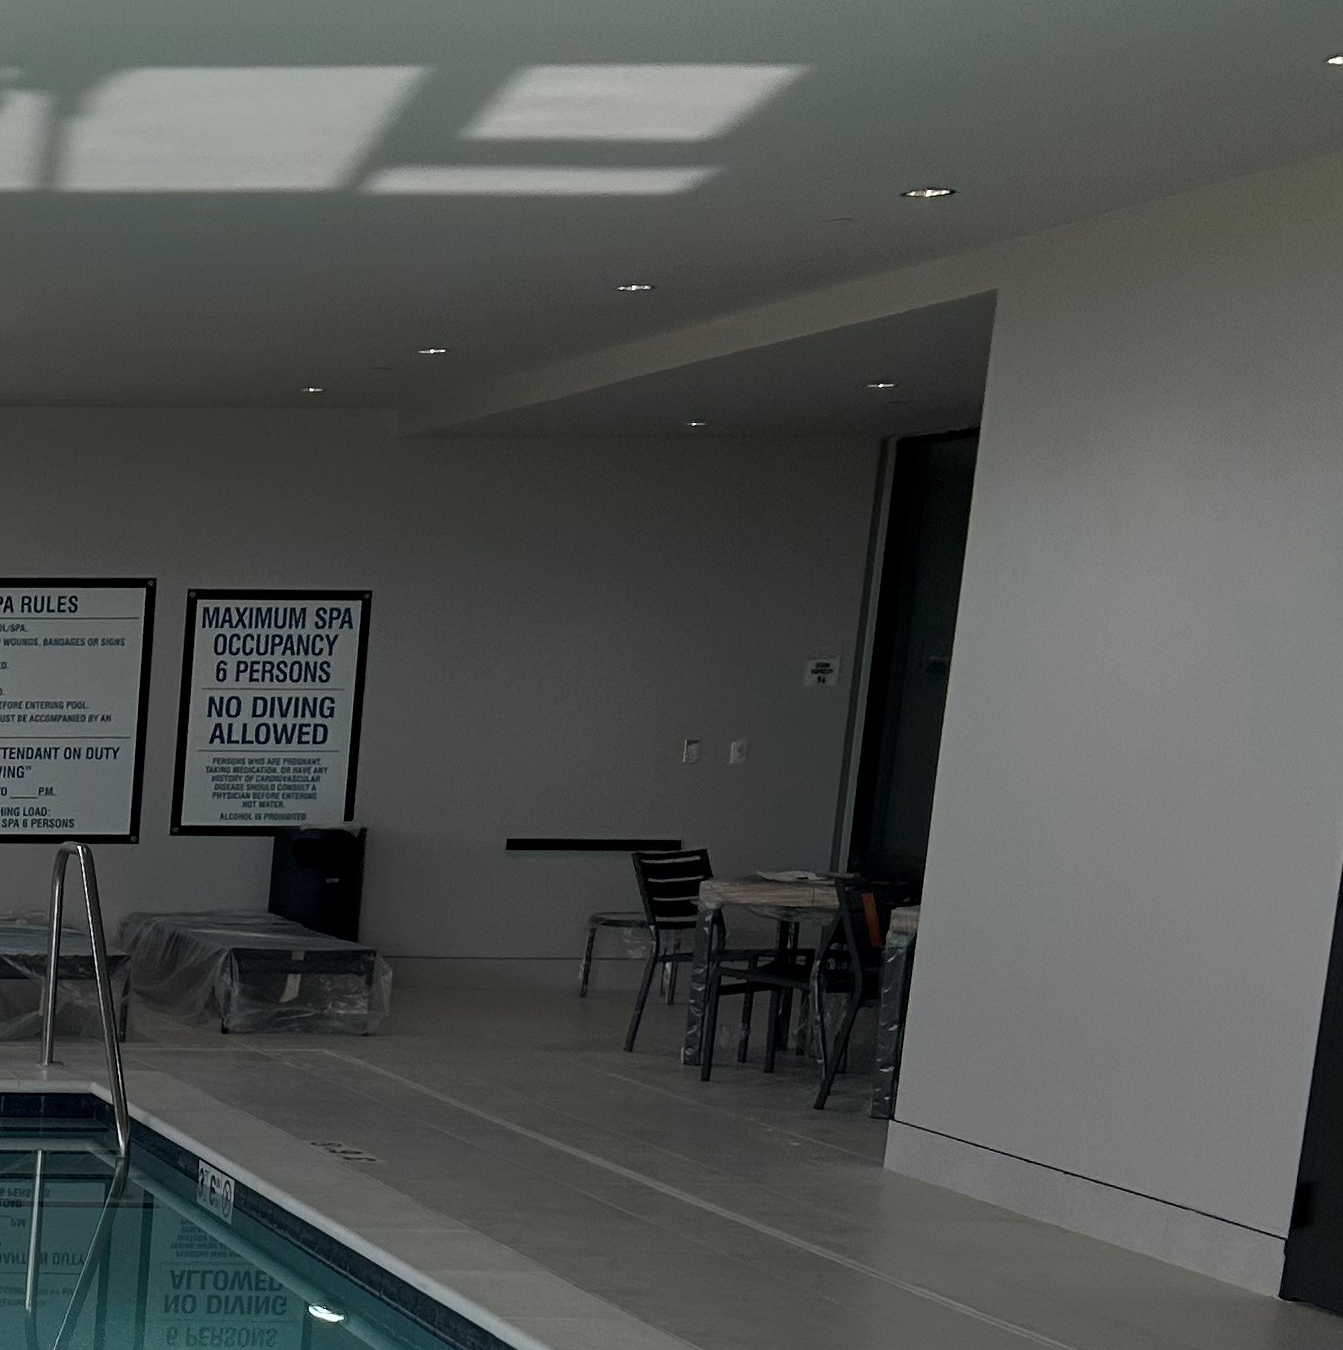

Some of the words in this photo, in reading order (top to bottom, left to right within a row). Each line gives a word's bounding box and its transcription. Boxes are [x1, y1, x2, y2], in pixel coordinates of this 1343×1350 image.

[21, 596, 78, 614] RULES
[202, 607, 306, 629] MAXIMUM
[314, 607, 353, 629] SPA
[214, 634, 338, 656] OCCUPANCY
[215, 661, 227, 683] 6
[235, 661, 331, 683] PERSONS
[207, 696, 242, 718] NO
[251, 696, 335, 718] DIVING
[209, 722, 328, 745] ALLOWED
[64, 747, 81, 760] ON
[86, 747, 119, 760] DUTY
[1, 819, 20, 828] SPA
[22, 819, 28, 828] 6
[31, 819, 74, 828] PERSONS
